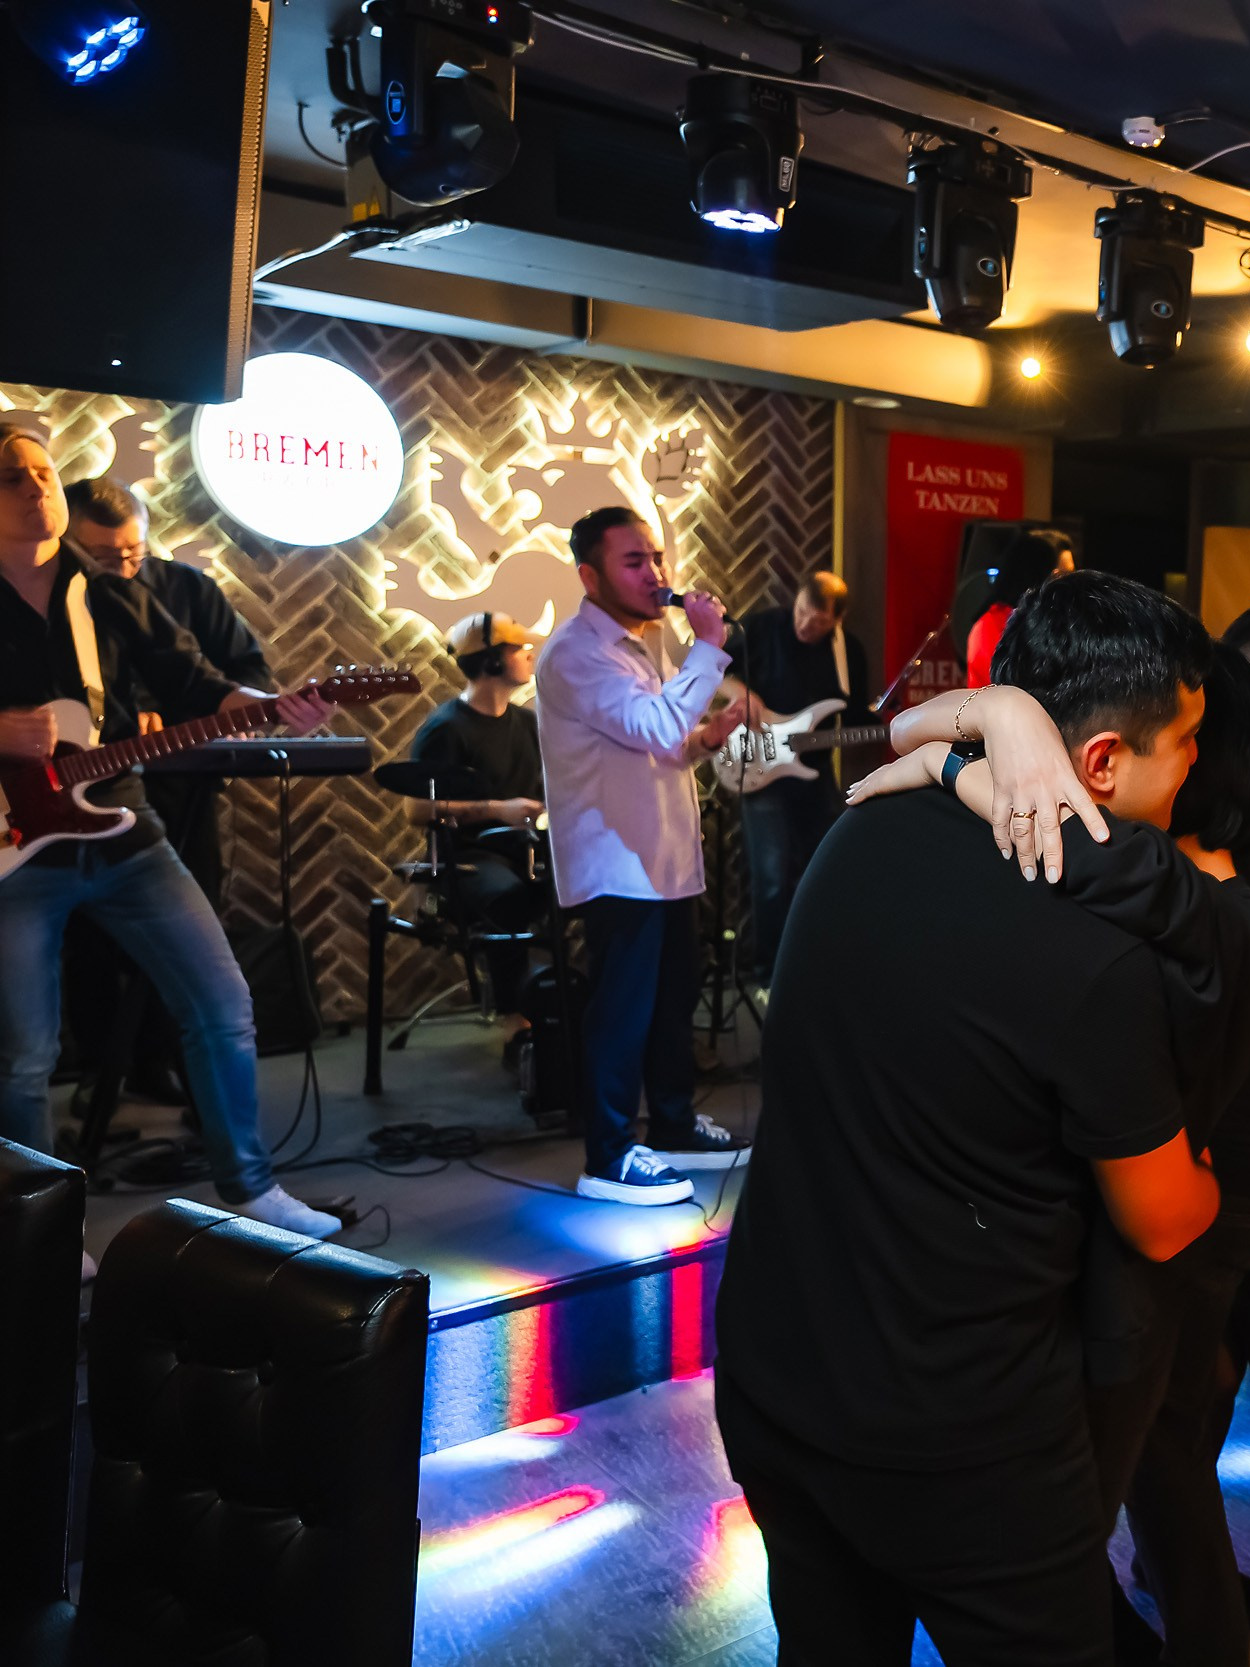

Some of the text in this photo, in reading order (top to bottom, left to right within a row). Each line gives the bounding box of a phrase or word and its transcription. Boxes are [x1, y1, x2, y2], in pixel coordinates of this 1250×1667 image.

[228, 430, 378, 471] BREMEN
[907, 461, 1008, 491] LASS UNS
[915, 489, 999, 515] TANZEN
